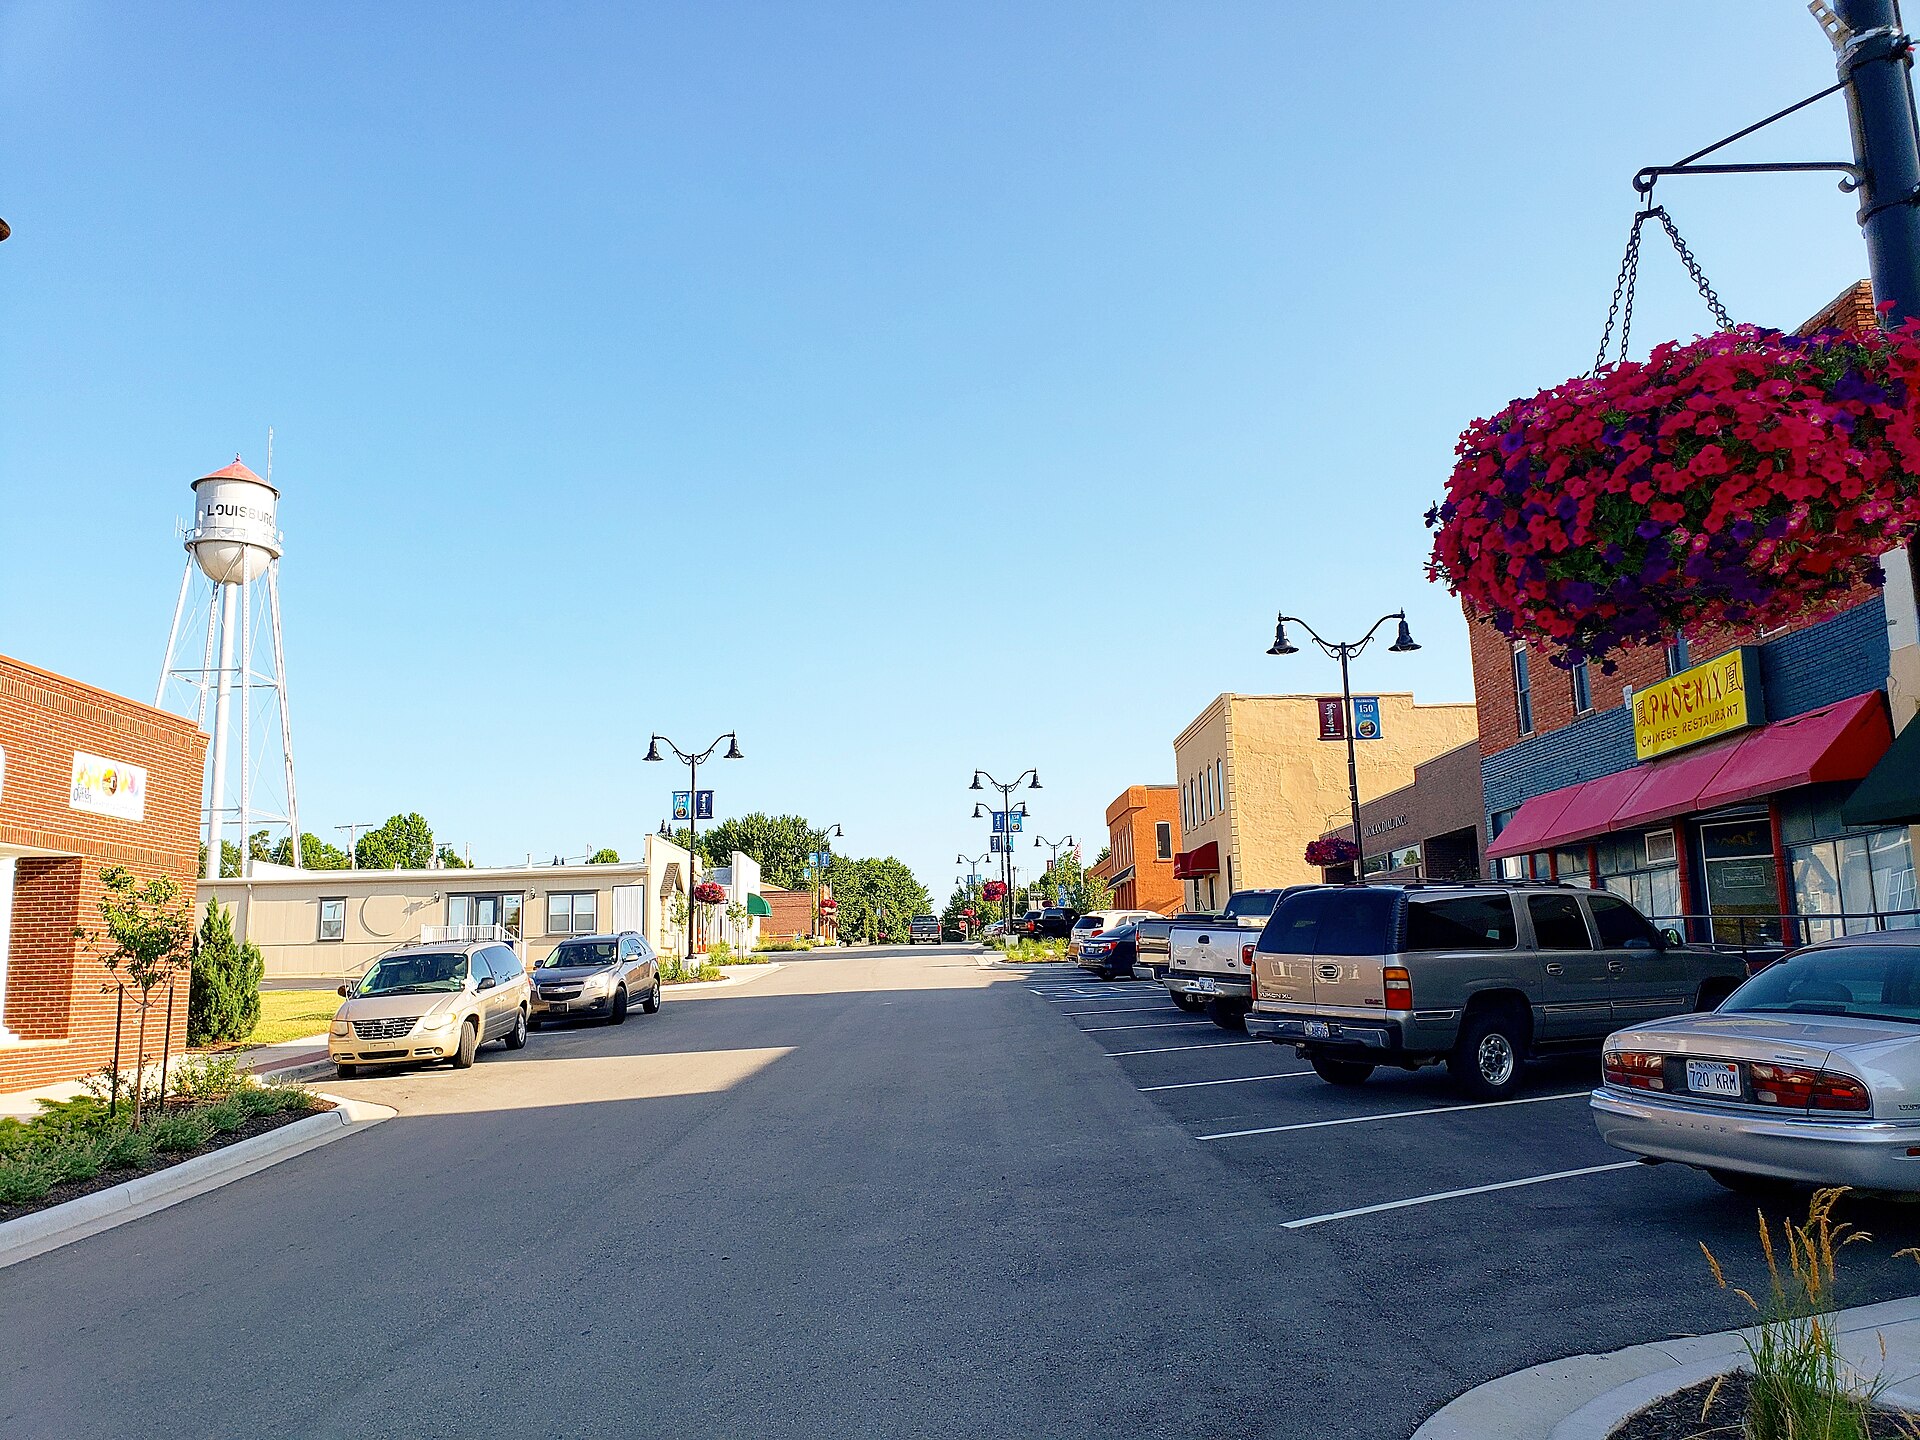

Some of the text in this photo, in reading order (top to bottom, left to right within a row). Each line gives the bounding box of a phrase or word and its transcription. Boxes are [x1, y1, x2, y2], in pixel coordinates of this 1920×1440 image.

[1650, 670, 1722, 725] PHOENIX
[1358, 704, 1374, 713] 150
[1642, 702, 1739, 748] CHINESE RESTAURANT
[1698, 1062, 1728, 1070] KANSAS
[1689, 1070, 1737, 1091] 720 KRM
